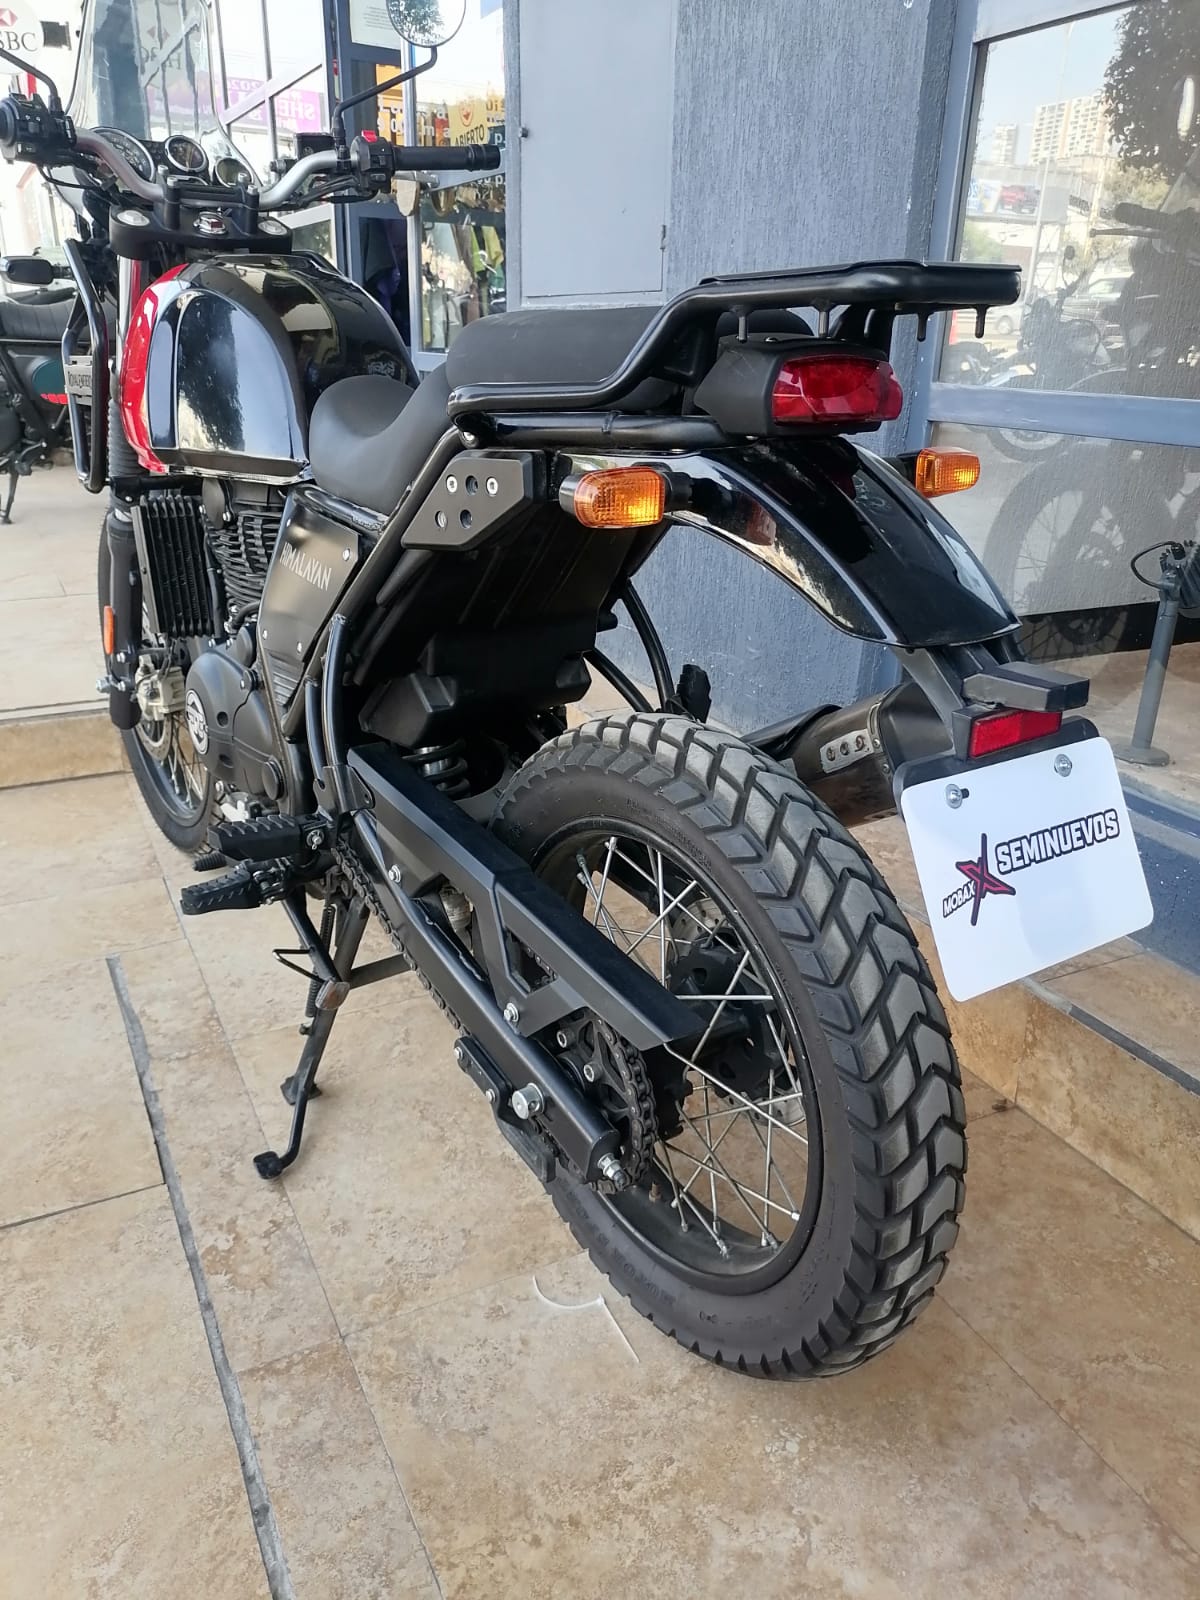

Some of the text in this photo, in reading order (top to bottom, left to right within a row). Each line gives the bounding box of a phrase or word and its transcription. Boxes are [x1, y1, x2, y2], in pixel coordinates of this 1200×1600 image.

[455, 124, 485, 147] ABIERTO
[280, 541, 332, 592] HIMALAYAN
[994, 808, 1120, 875] SEMINUEVOS
